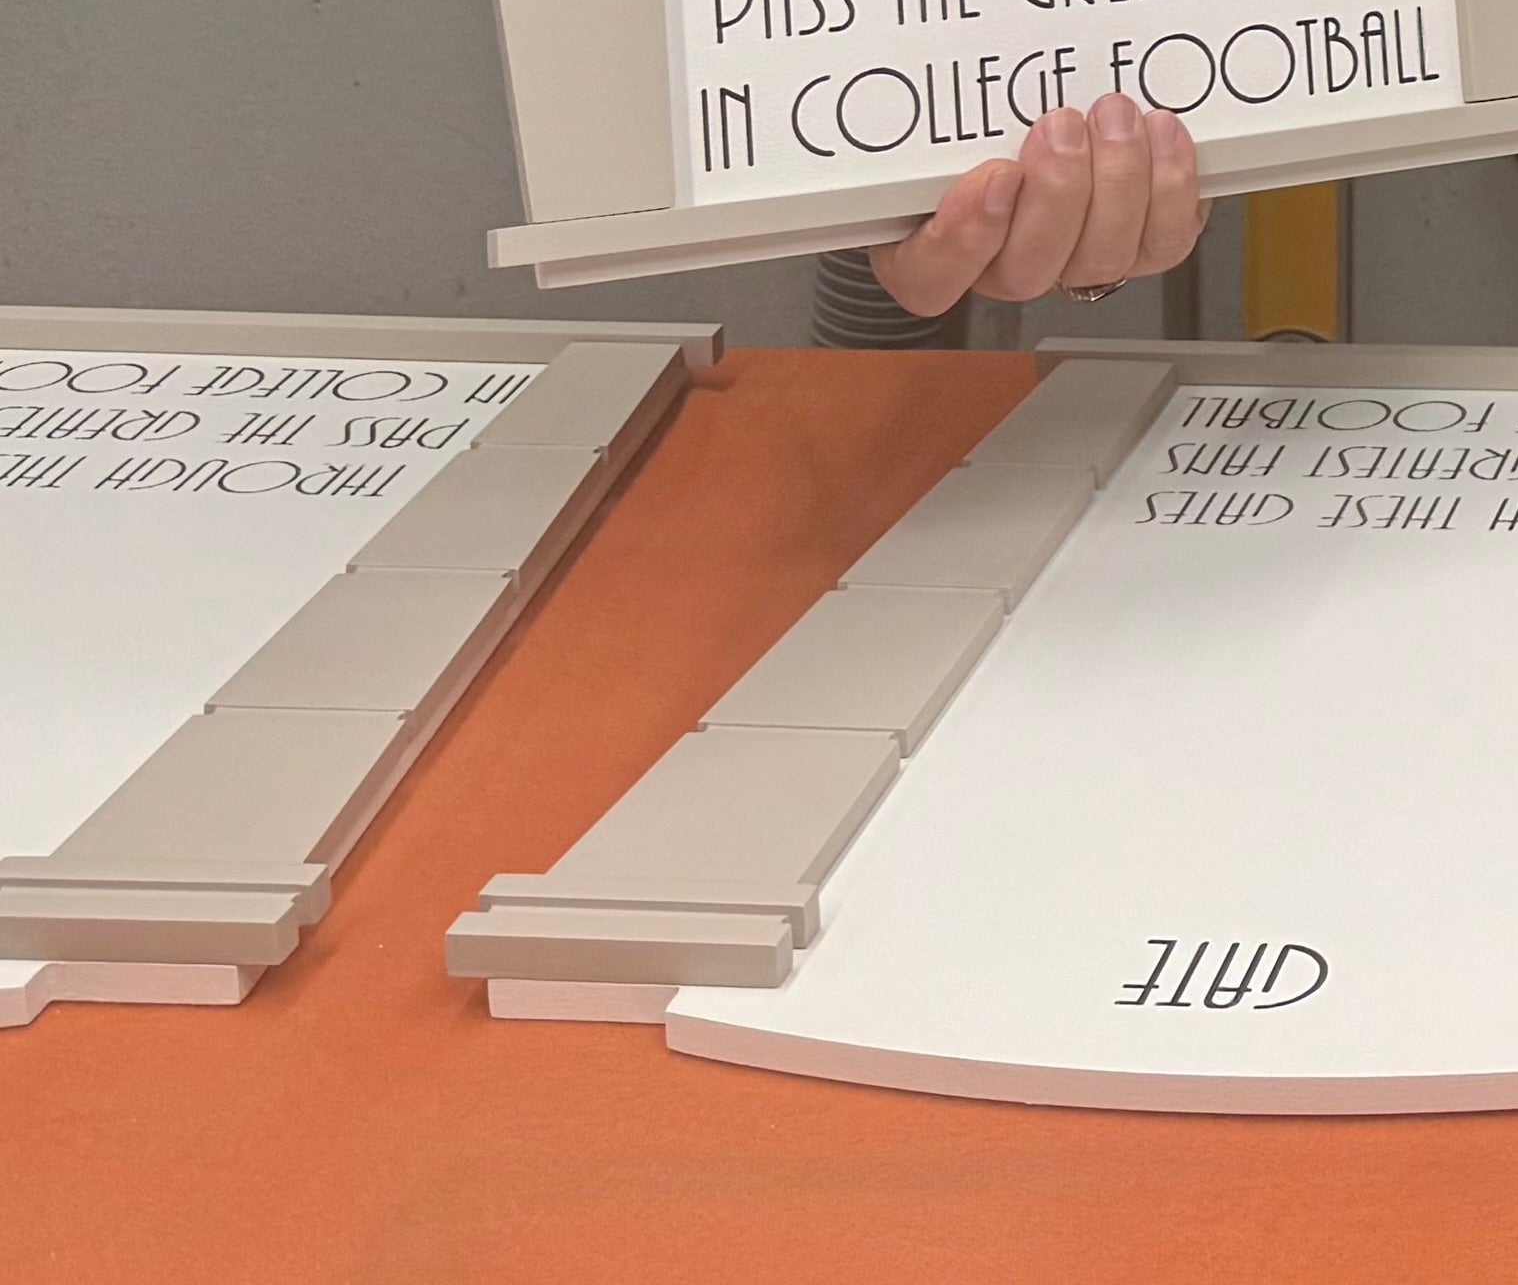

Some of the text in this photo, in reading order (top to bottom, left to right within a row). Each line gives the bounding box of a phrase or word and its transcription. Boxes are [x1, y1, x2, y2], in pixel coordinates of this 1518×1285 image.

[701, 6, 1440, 172] IN COLLEGE FOOTBALL
[184, 366, 448, 401] COLLEGE
[464, 375, 529, 404] IN
[222, 413, 316, 445] THE
[1182, 398, 1495, 432] FOOTBALL
[329, 417, 470, 449] PASS
[1166, 443, 1285, 476] FANS
[94, 458, 406, 497] THROUGH
[1136, 491, 1294, 525] GATES
[1318, 495, 1461, 530] THESE
[1114, 940, 1328, 1009] GATE
